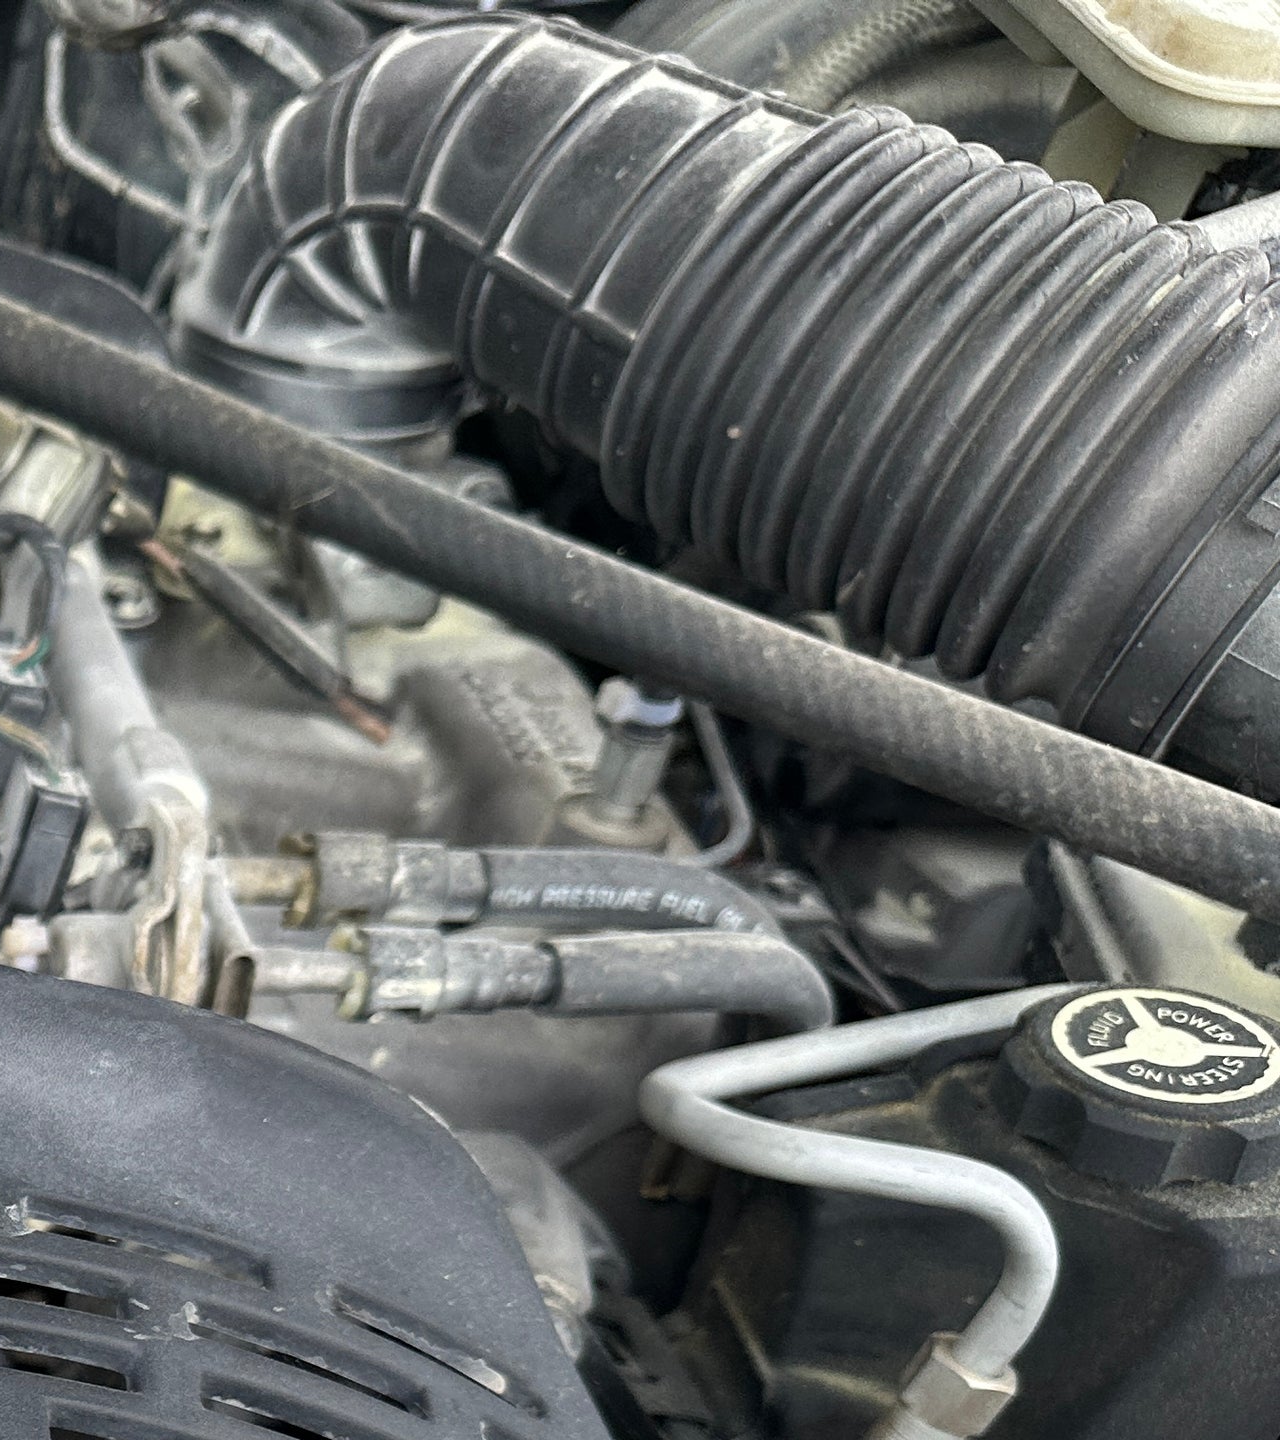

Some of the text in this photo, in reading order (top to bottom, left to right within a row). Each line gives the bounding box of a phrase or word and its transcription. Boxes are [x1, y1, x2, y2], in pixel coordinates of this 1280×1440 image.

[1087, 1011, 1124, 1048] FLUID
[1157, 1007, 1236, 1043] POWER
[1126, 1056, 1245, 1087] STEERING
